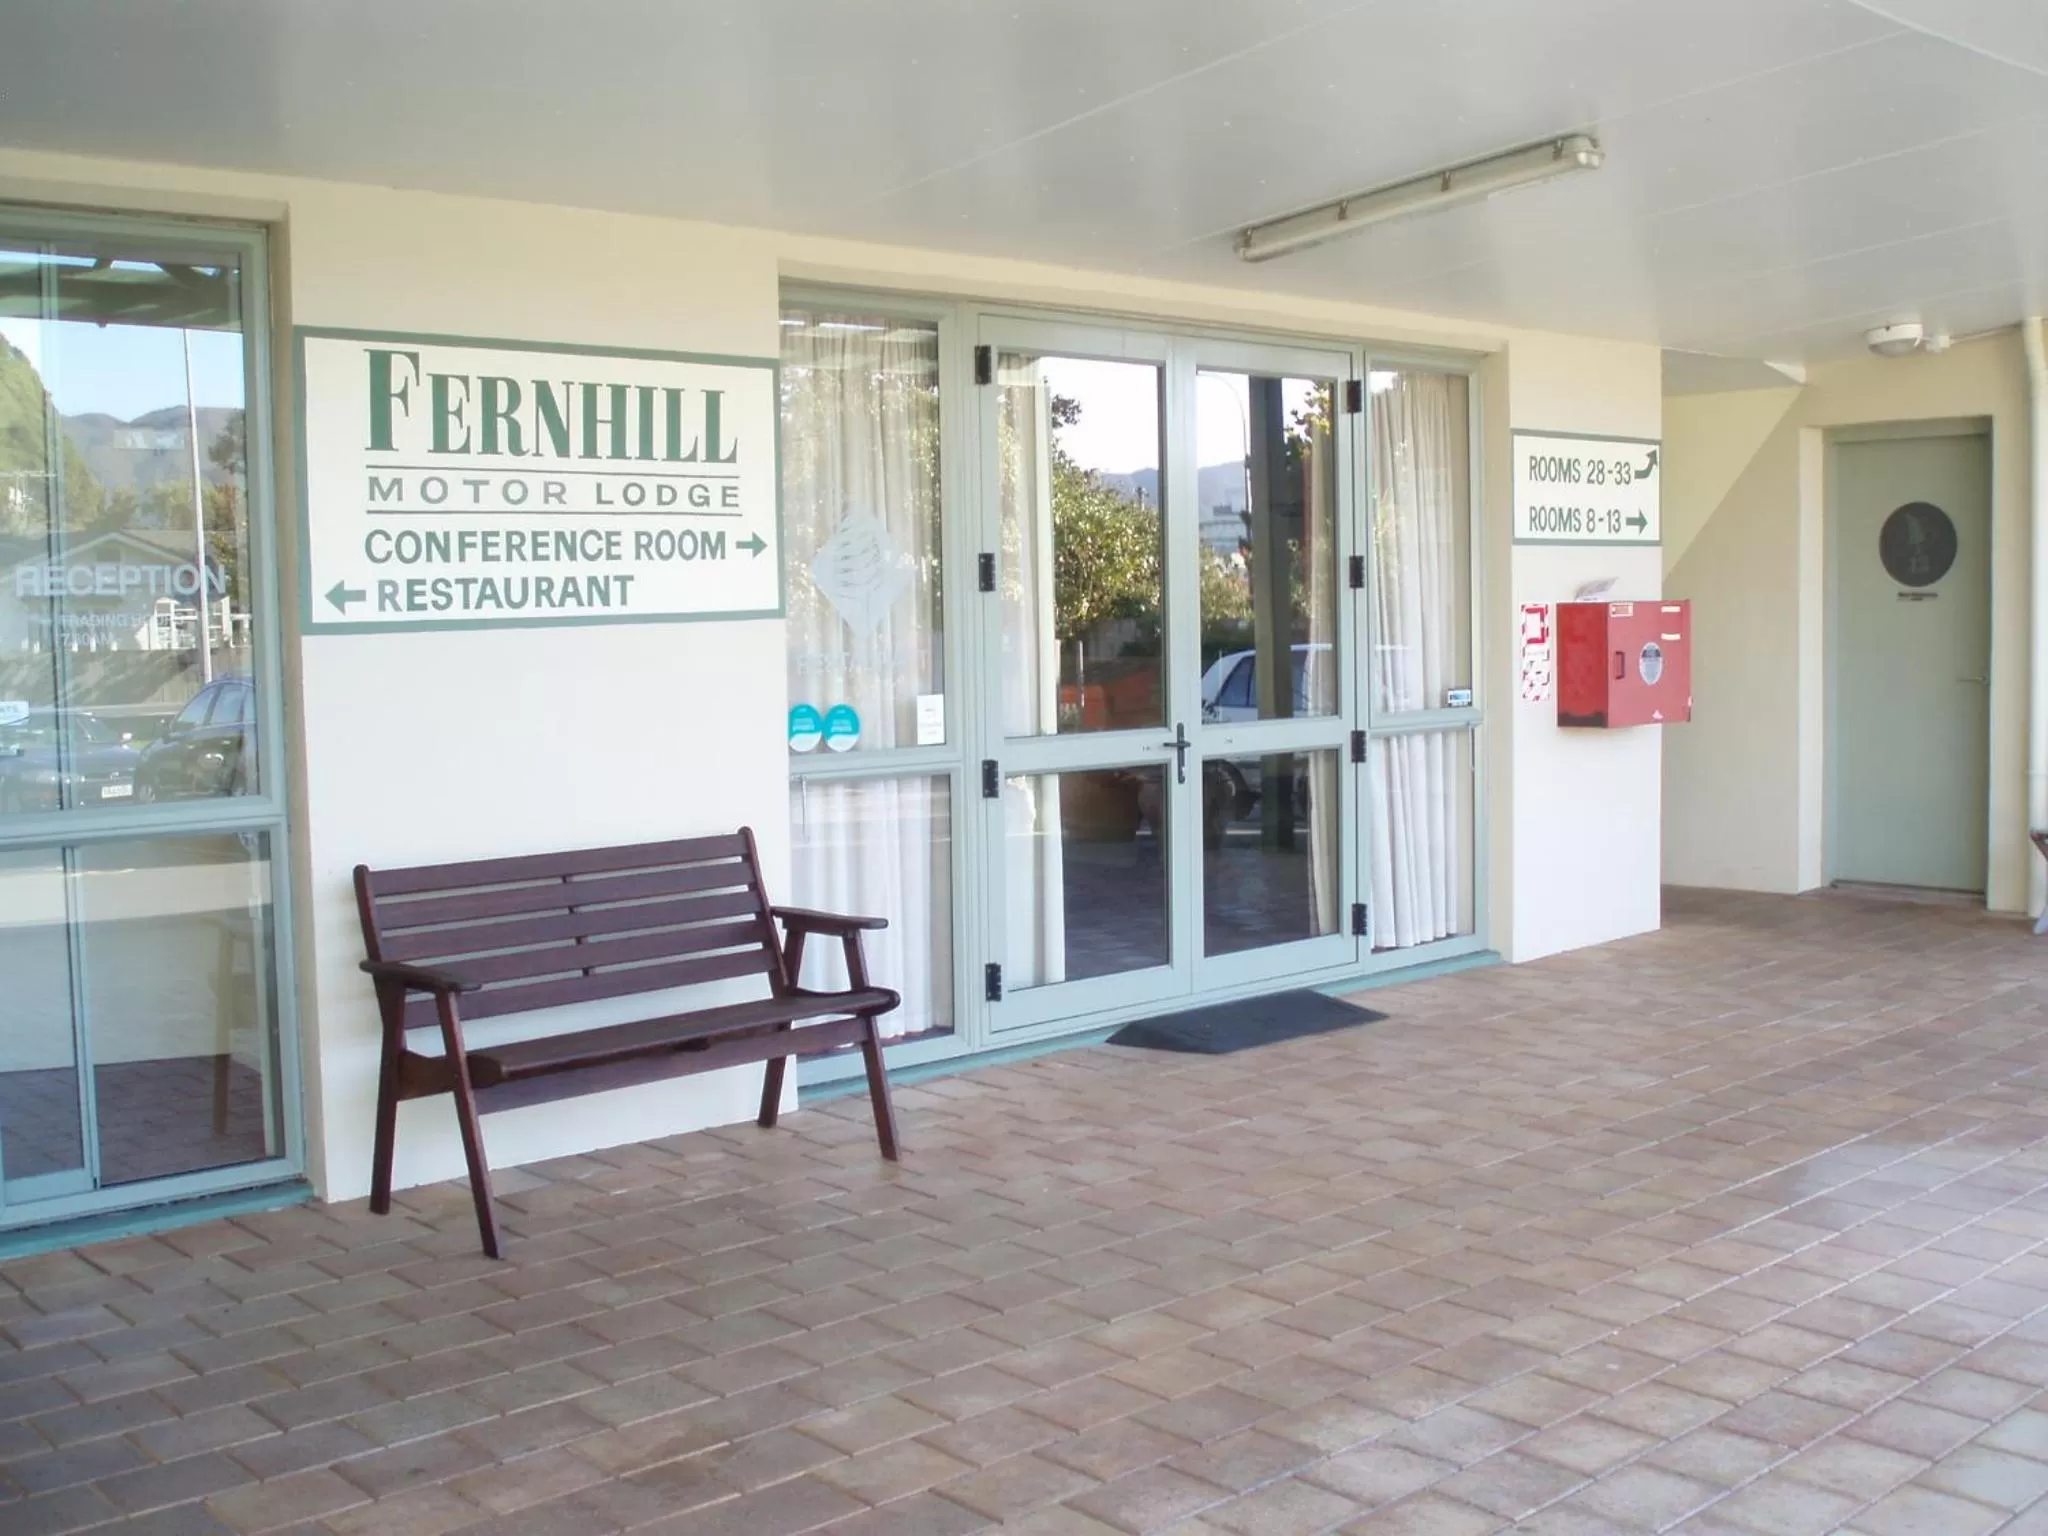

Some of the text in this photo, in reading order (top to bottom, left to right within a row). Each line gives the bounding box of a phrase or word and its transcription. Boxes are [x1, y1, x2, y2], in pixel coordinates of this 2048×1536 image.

[363, 348, 738, 465] FERNHILL
[1528, 455, 1581, 484] ROOMS
[367, 475, 740, 508] MOTOR LODGE
[1528, 505, 1582, 533] ROOMS
[364, 528, 727, 564] CONFERENCE ROOM
[14, 563, 226, 597] RECEPTION
[377, 574, 635, 613] RESTAURANT
